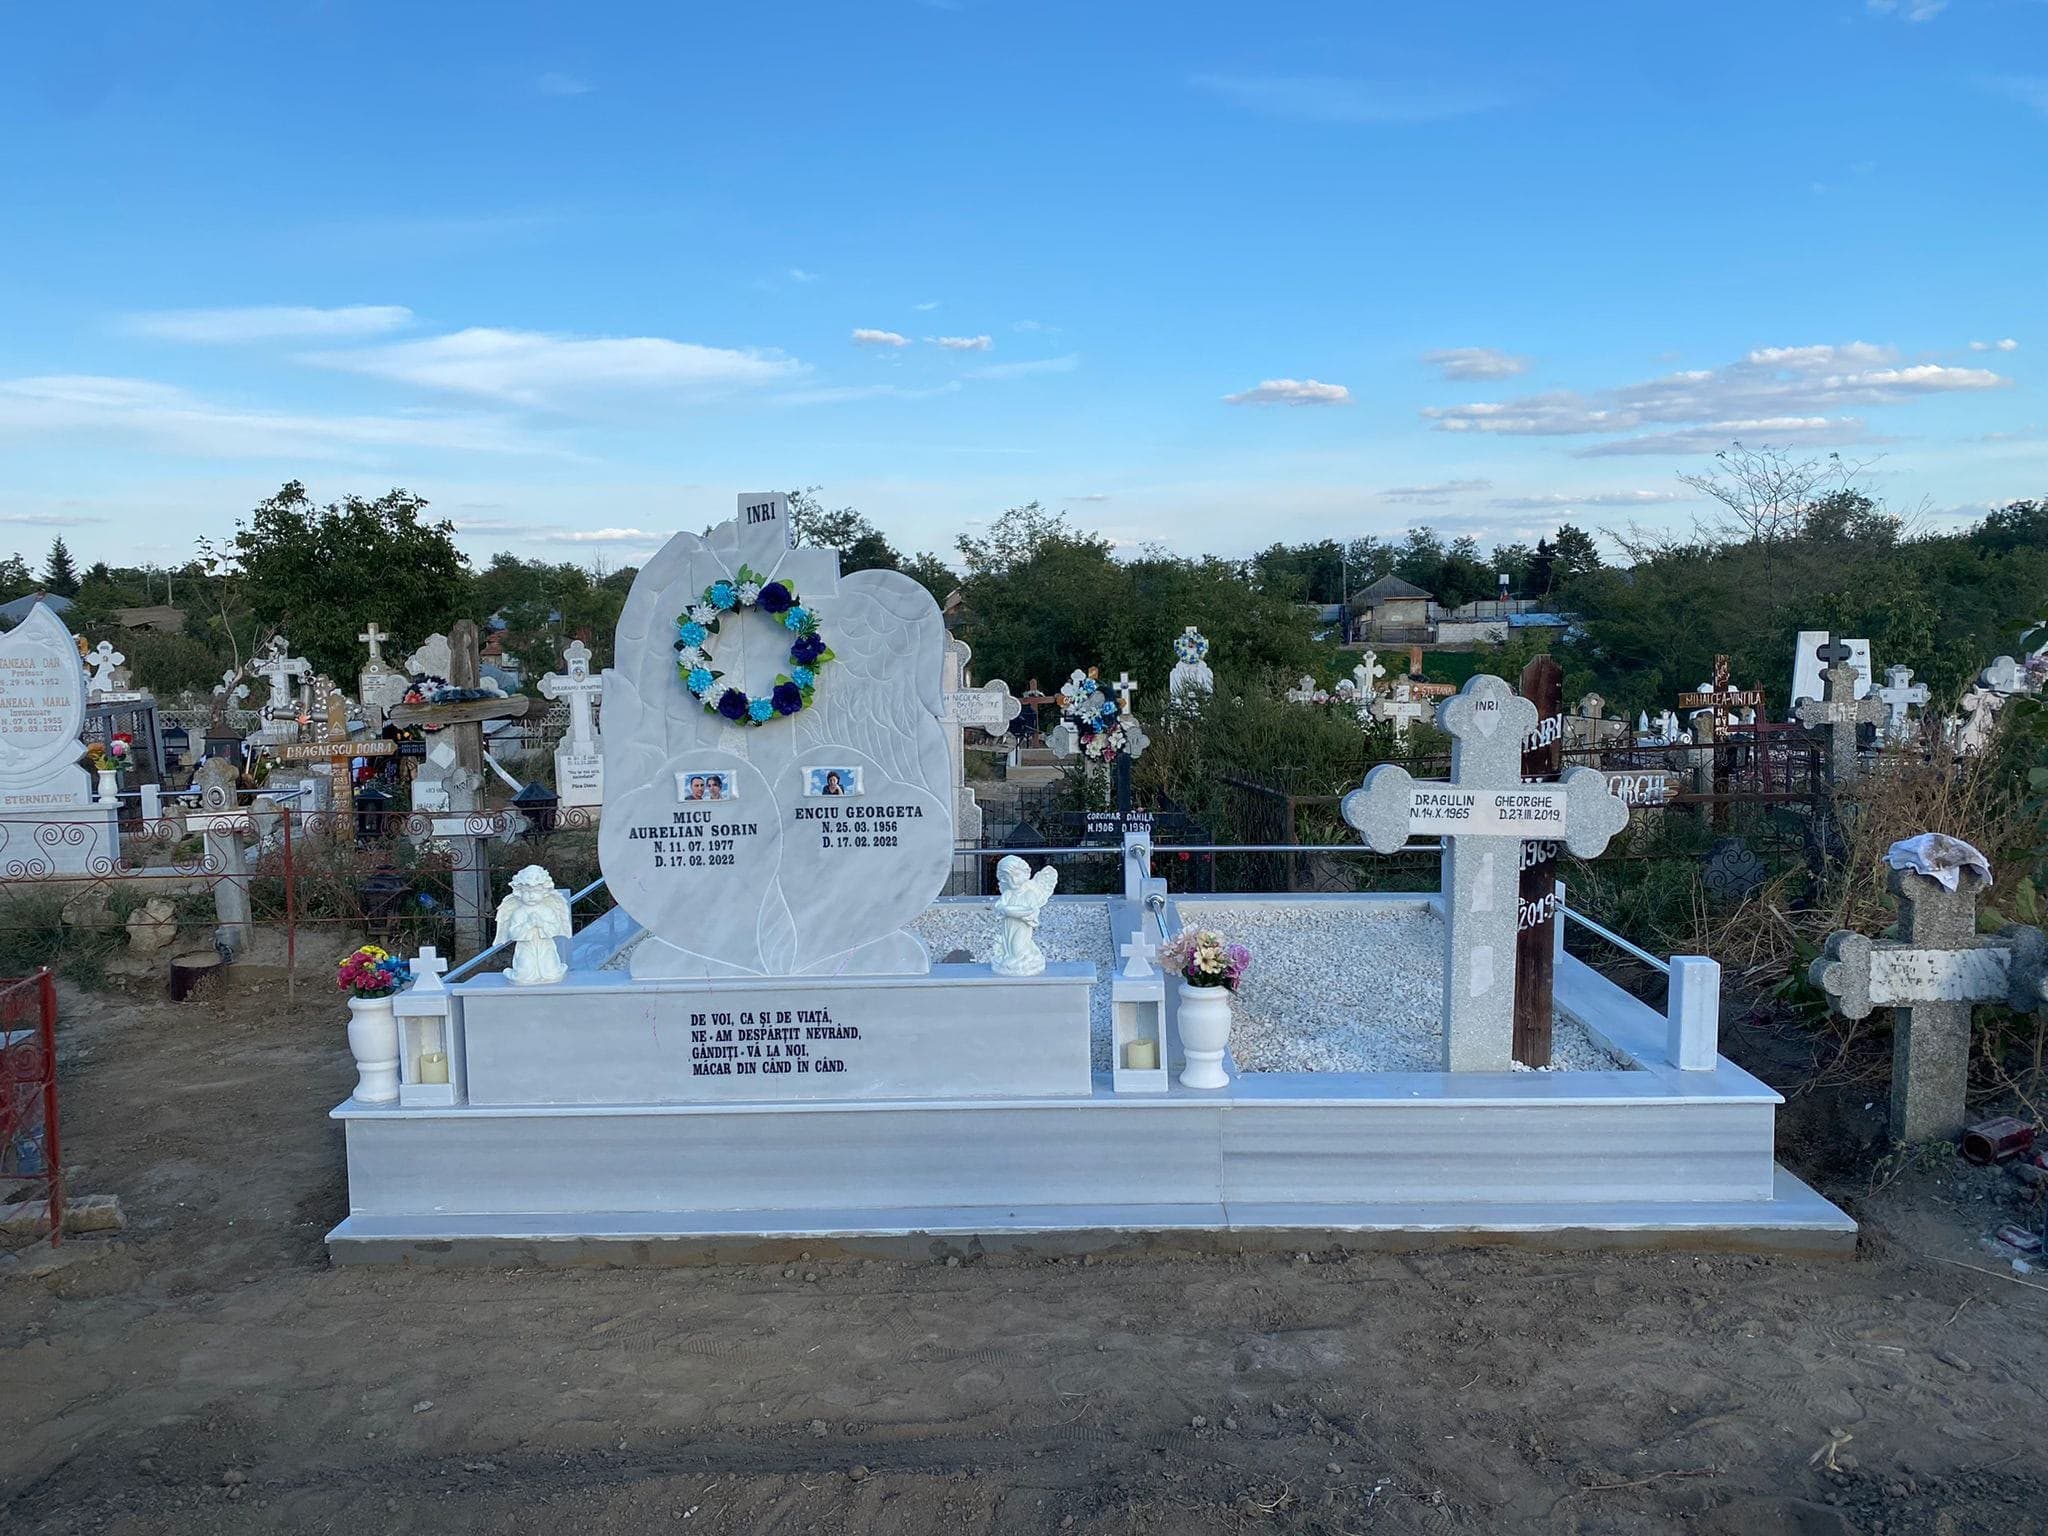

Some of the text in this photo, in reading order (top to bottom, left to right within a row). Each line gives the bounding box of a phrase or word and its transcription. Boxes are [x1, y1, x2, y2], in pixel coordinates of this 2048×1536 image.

[747, 502, 776, 524] INRI
[1475, 700, 1499, 711] INRI
[287, 744, 353, 758] DRAGNESCU
[1415, 794, 1553, 808] DRAGULIN GHEORGHE
[673, 811, 712, 824] MICU
[795, 806, 923, 820] ENCIU GEORGETA
[629, 823, 758, 839] AURELIAN SORIN
[822, 821, 898, 833] N. 25. 03. 1956
[654, 840, 734, 853] N. 11. 07. 1977
[822, 836, 898, 848] D. 17. 02. 2022
[655, 854, 735, 867] D. 17. 02. 2022
[691, 1013, 706, 1026] DE
[712, 1013, 734, 1027] VOI,
[740, 1012, 754, 1025] CA
[776, 1011, 791, 1024] DE
[766, 1045, 780, 1057] LA
[785, 1044, 809, 1058] NOI,
[737, 1061, 756, 1075] DIN
